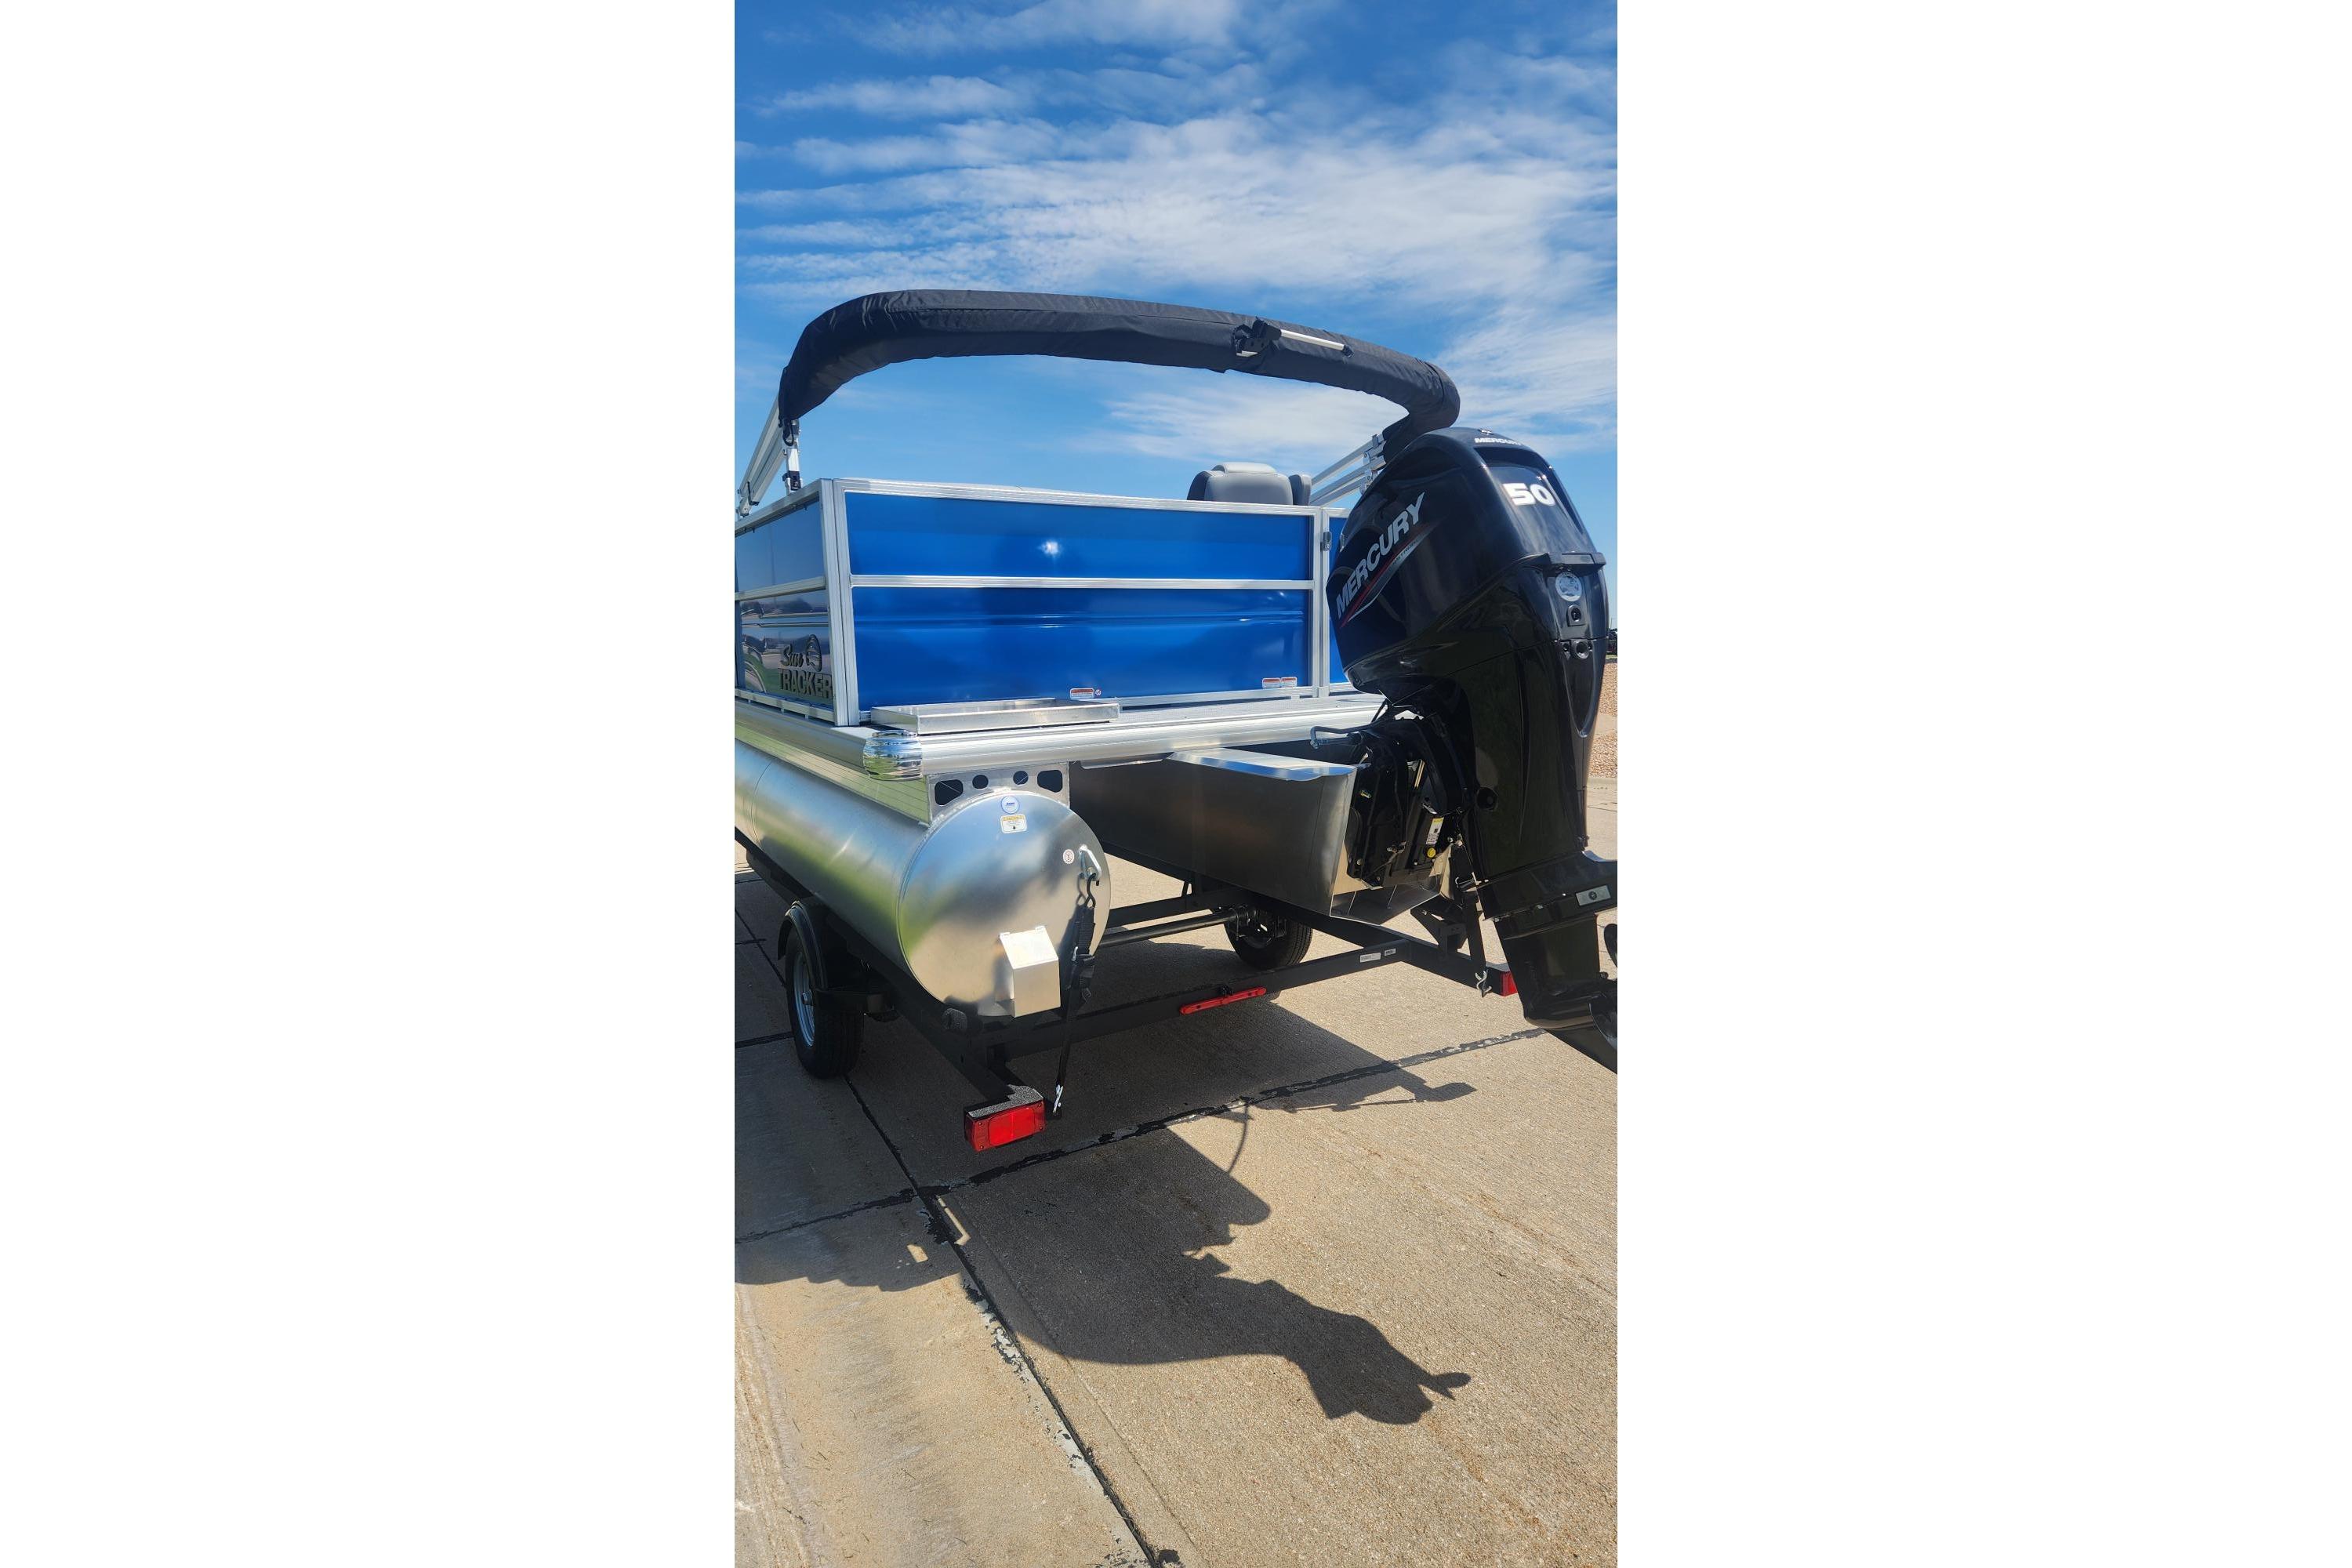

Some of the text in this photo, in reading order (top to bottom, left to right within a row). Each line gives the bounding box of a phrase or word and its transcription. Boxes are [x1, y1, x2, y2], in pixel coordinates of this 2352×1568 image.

[1502, 482, 1556, 506] 50
[1335, 492, 1425, 619] MERCURY
[781, 643, 804, 667] Sun
[778, 667, 833, 699] TRACKER
